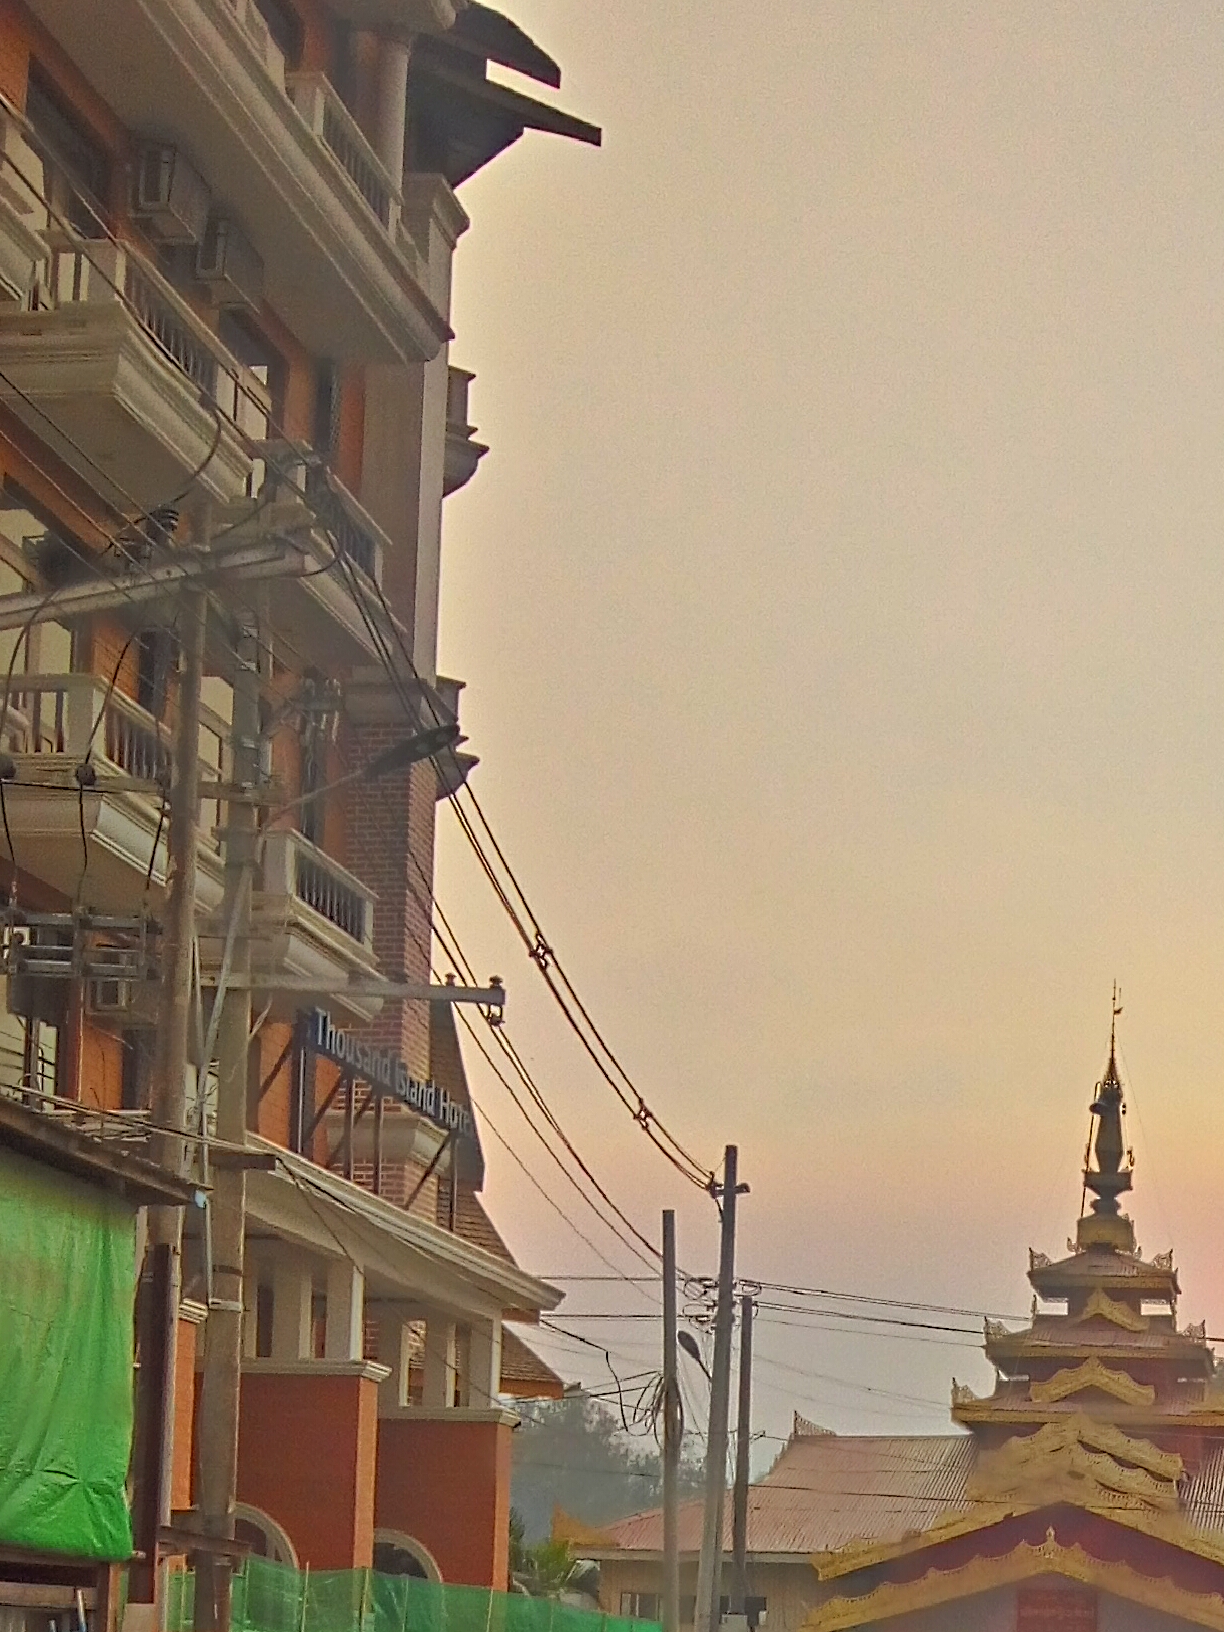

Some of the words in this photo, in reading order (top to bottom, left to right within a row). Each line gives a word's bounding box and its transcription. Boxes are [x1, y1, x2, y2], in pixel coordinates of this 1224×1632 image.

[315, 1006, 391, 1087] Thousand
[395, 1057, 435, 1115] Island
[440, 1088, 472, 1136] Hote
